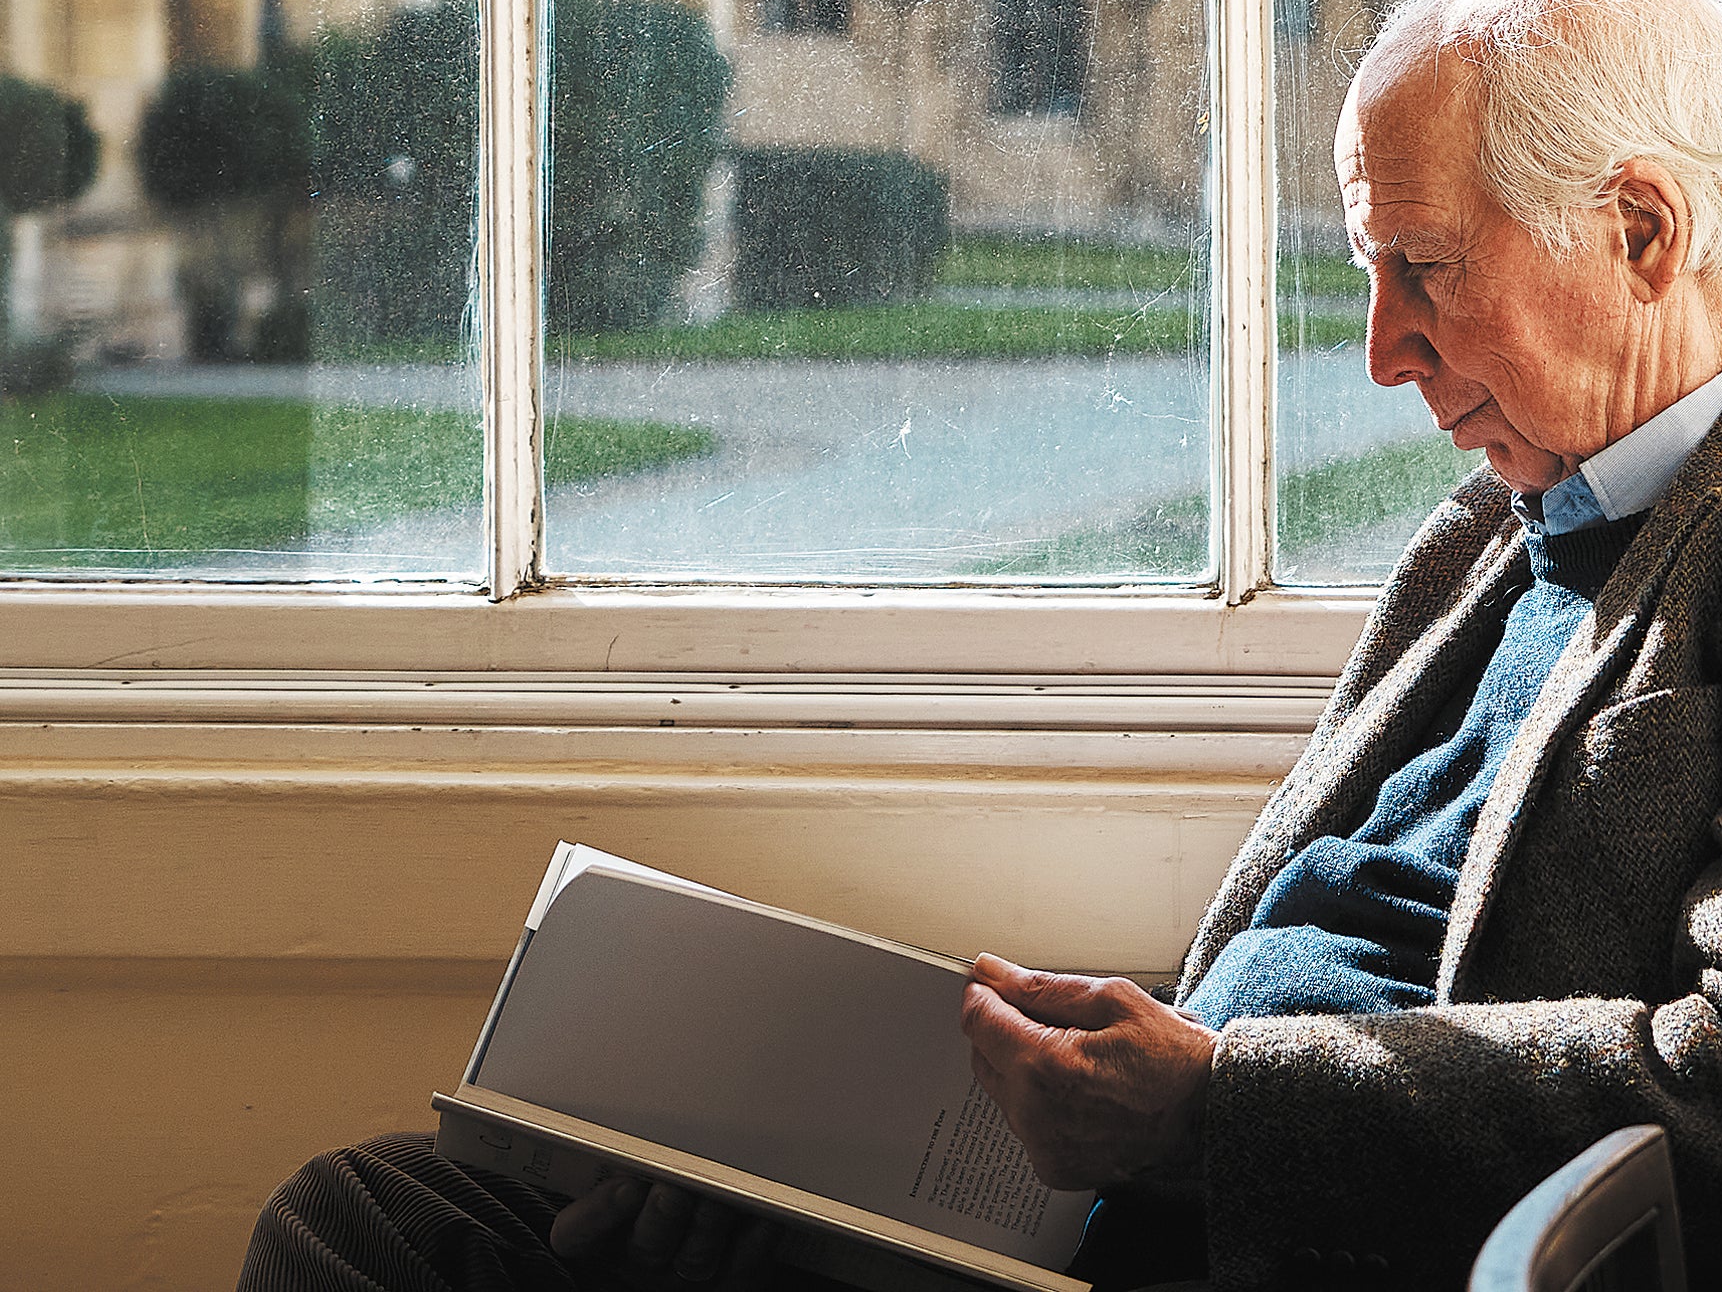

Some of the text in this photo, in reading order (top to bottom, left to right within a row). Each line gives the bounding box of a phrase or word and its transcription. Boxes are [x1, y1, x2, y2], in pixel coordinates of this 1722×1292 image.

[940, 1183, 950, 1196] The
[946, 1158, 961, 1180] Poetry
[948, 1187, 960, 1210] always
[956, 1166, 966, 1185] been
[964, 1136, 978, 1164] amazed
[973, 1120, 984, 1135] how
[957, 1197, 966, 1213] able
[974, 1141, 985, 1165] myself
[983, 1126, 992, 1140] and
[964, 1202, 974, 1215] The
[972, 1173, 985, 1200] exercise
[984, 1154, 992, 1165] set
[979, 1196, 987, 1209] one
[996, 1149, 1004, 1163] and
[1000, 1132, 1010, 1148] then
[984, 1205, 995, 1222] draft
[998, 1164, 1009, 1176] The
[1005, 1145, 1016, 1162] draft
[1001, 1191, 1010, 1203] but
[1007, 1170, 1017, 1185] had
[1002, 1212, 1012, 1228] from
[1011, 1186, 1022, 1199] The
[1011, 1211, 1023, 1230] There
[1021, 1195, 1029, 1208] was
[1022, 1214, 1032, 1234] which
[1030, 1211, 1044, 1237] Andrew
